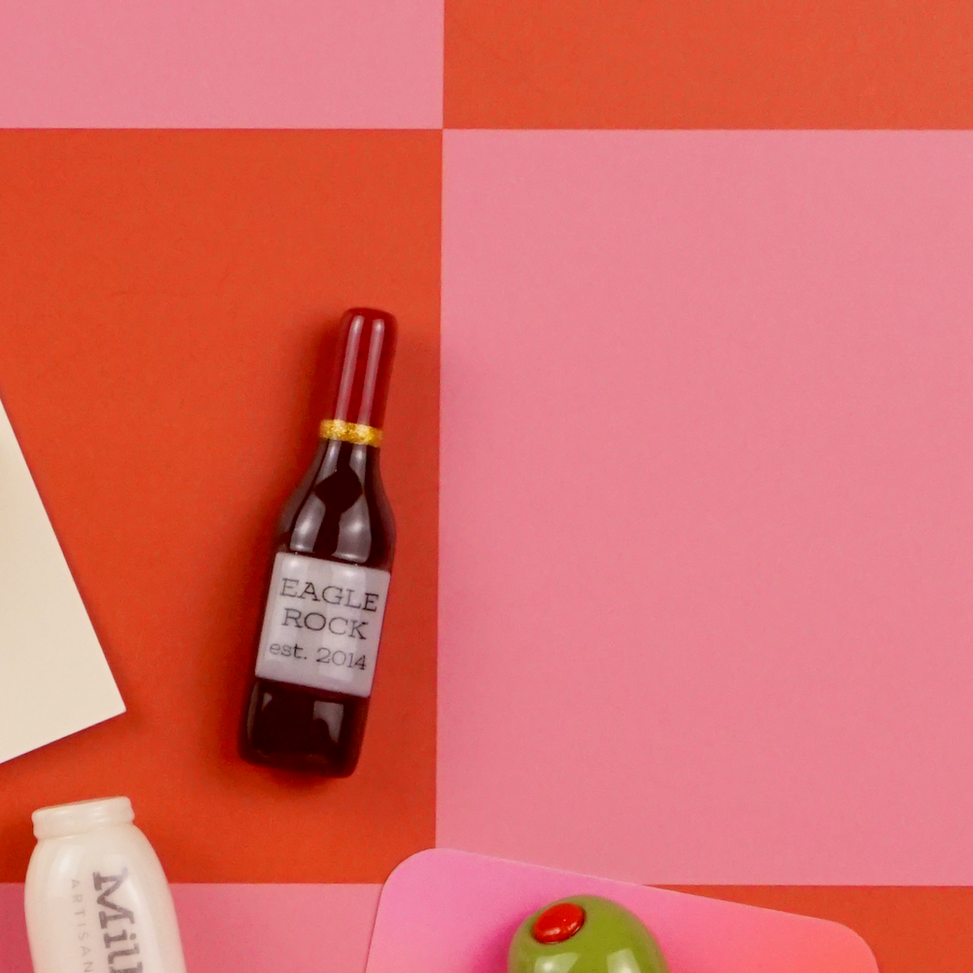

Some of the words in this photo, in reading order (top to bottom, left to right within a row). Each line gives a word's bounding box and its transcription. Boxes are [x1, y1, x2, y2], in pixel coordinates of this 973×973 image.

[279, 577, 380, 612] EAGLE
[281, 607, 369, 640] ROCK
[269, 642, 307, 660] est.
[315, 647, 367, 671] 2014
[70, 877, 94, 973] ARTISAN
